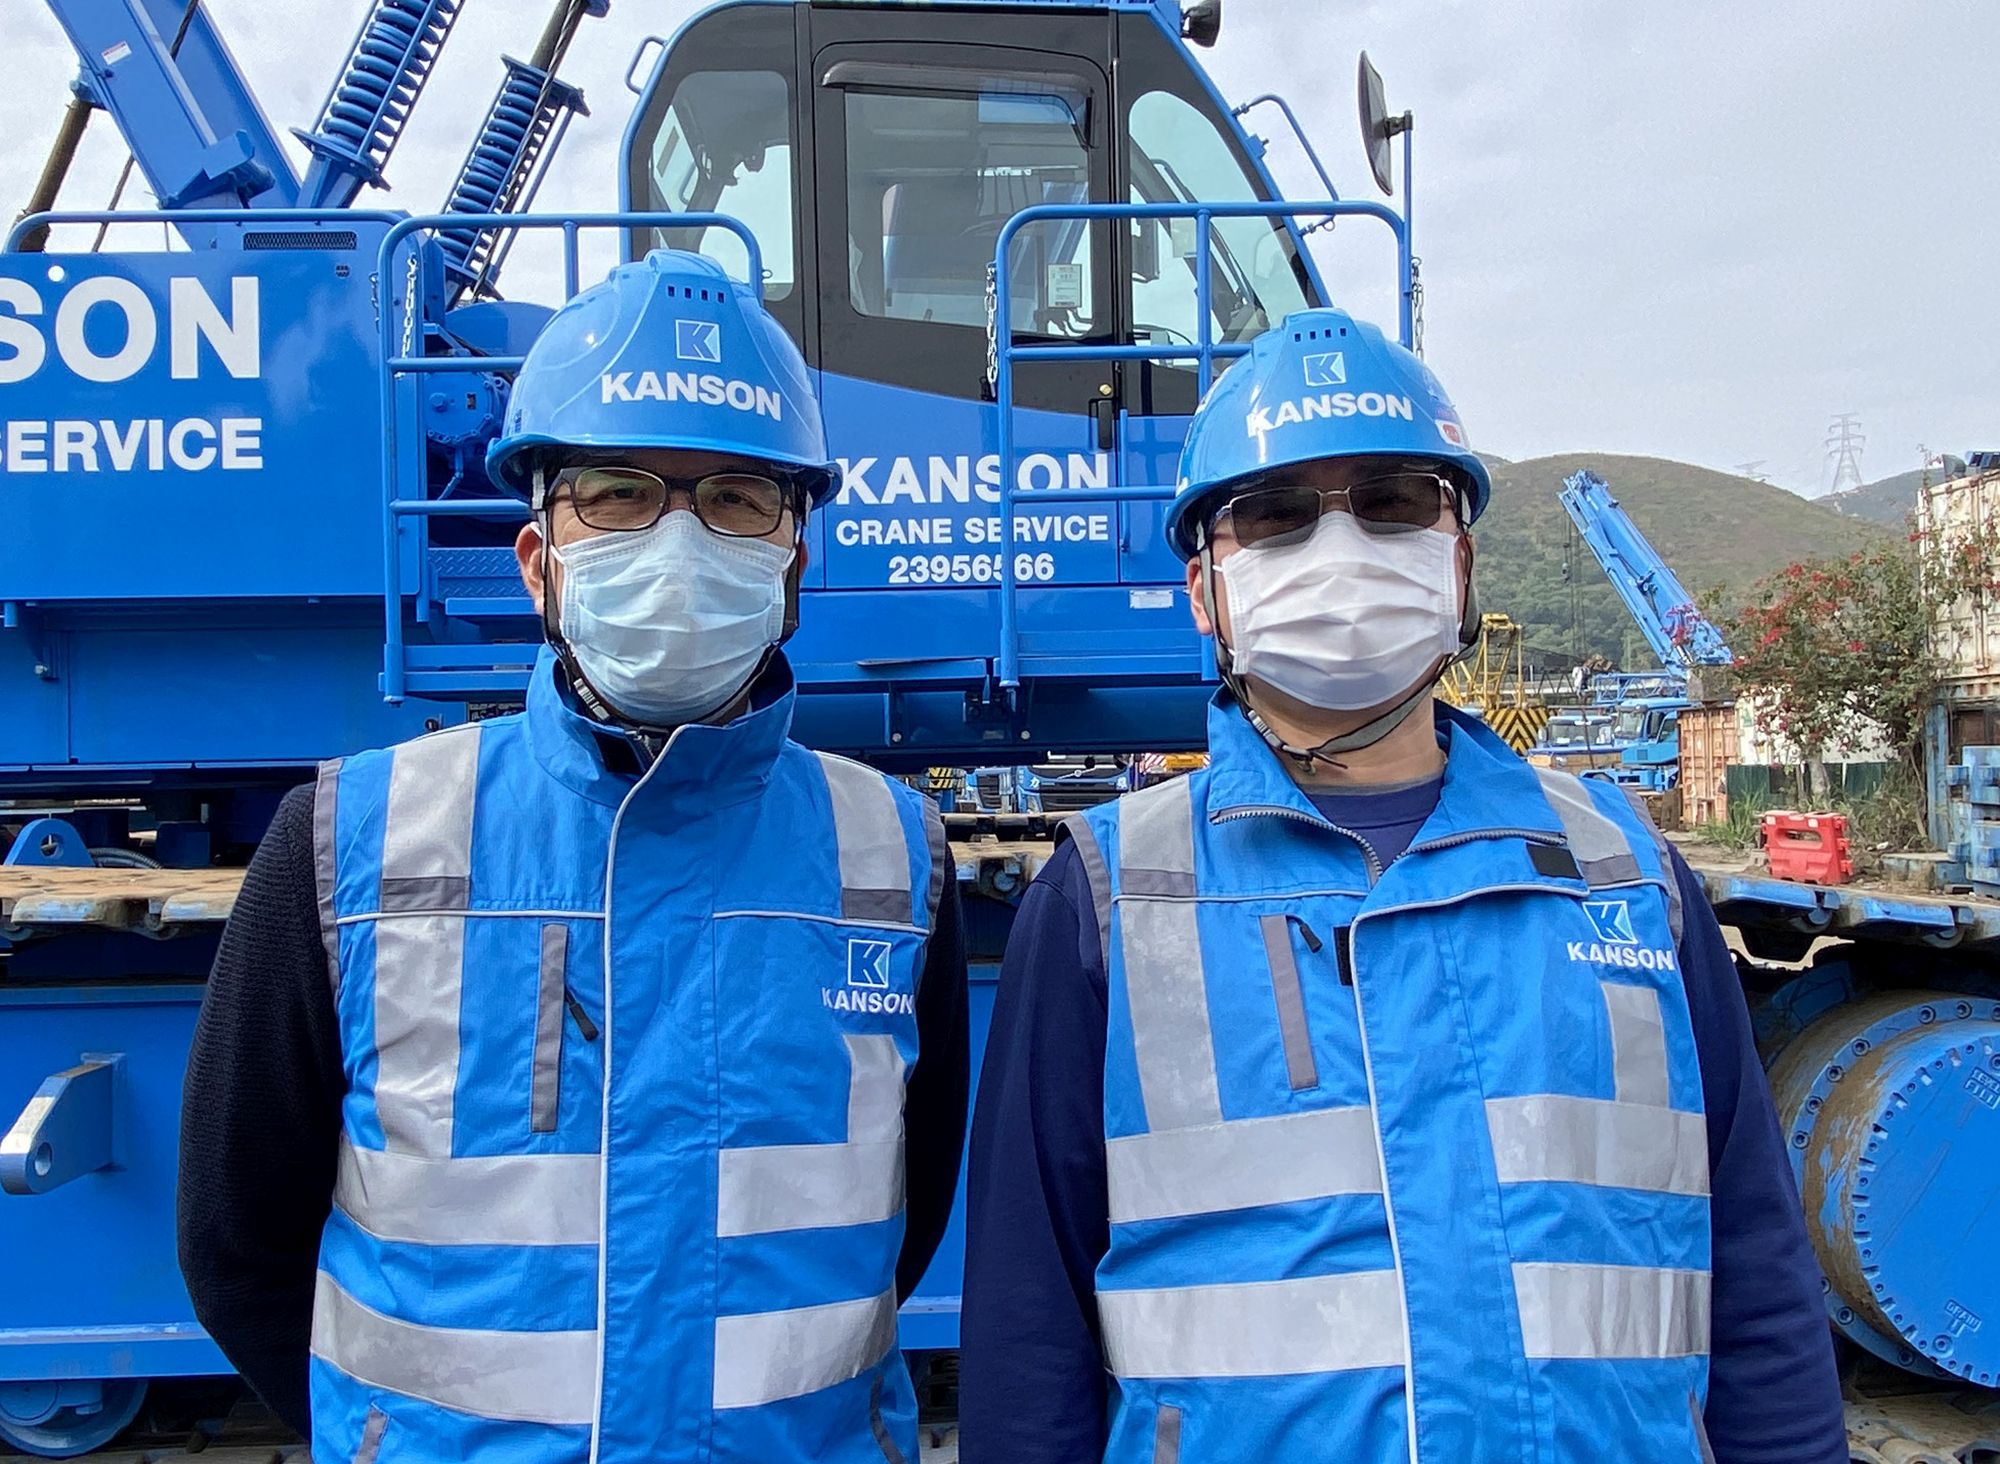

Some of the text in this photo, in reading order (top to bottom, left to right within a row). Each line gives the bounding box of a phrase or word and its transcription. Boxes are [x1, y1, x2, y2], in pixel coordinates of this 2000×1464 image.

[602, 371, 781, 421] KANSON
[1247, 392, 1413, 437] KANSON
[0, 418, 263, 472] ERVICE
[836, 453, 1108, 505] KANSON
[836, 515, 1108, 546] CRANE SERVICE
[1567, 942, 1675, 971] KANSON
[822, 987, 914, 1014] KANSON
